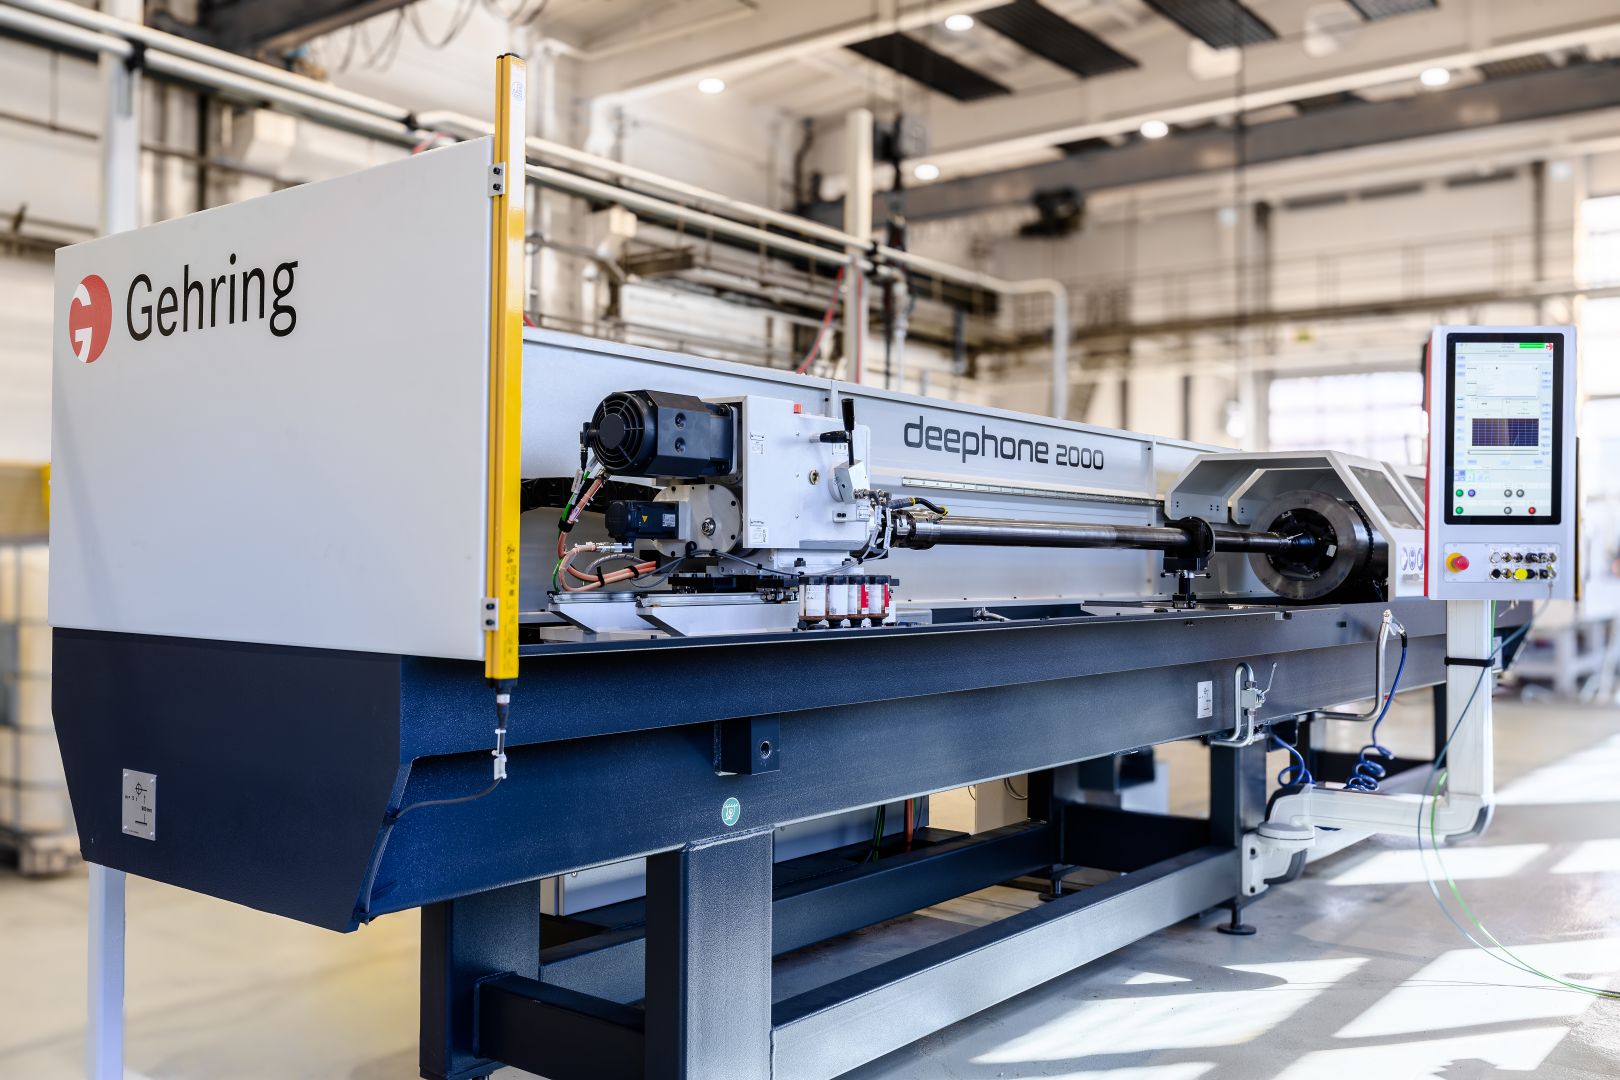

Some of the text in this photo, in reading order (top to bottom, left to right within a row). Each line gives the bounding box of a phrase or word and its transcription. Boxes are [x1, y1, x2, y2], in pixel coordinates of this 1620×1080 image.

[126, 252, 299, 342] Gehring
[903, 415, 1105, 471] deephone 2000
